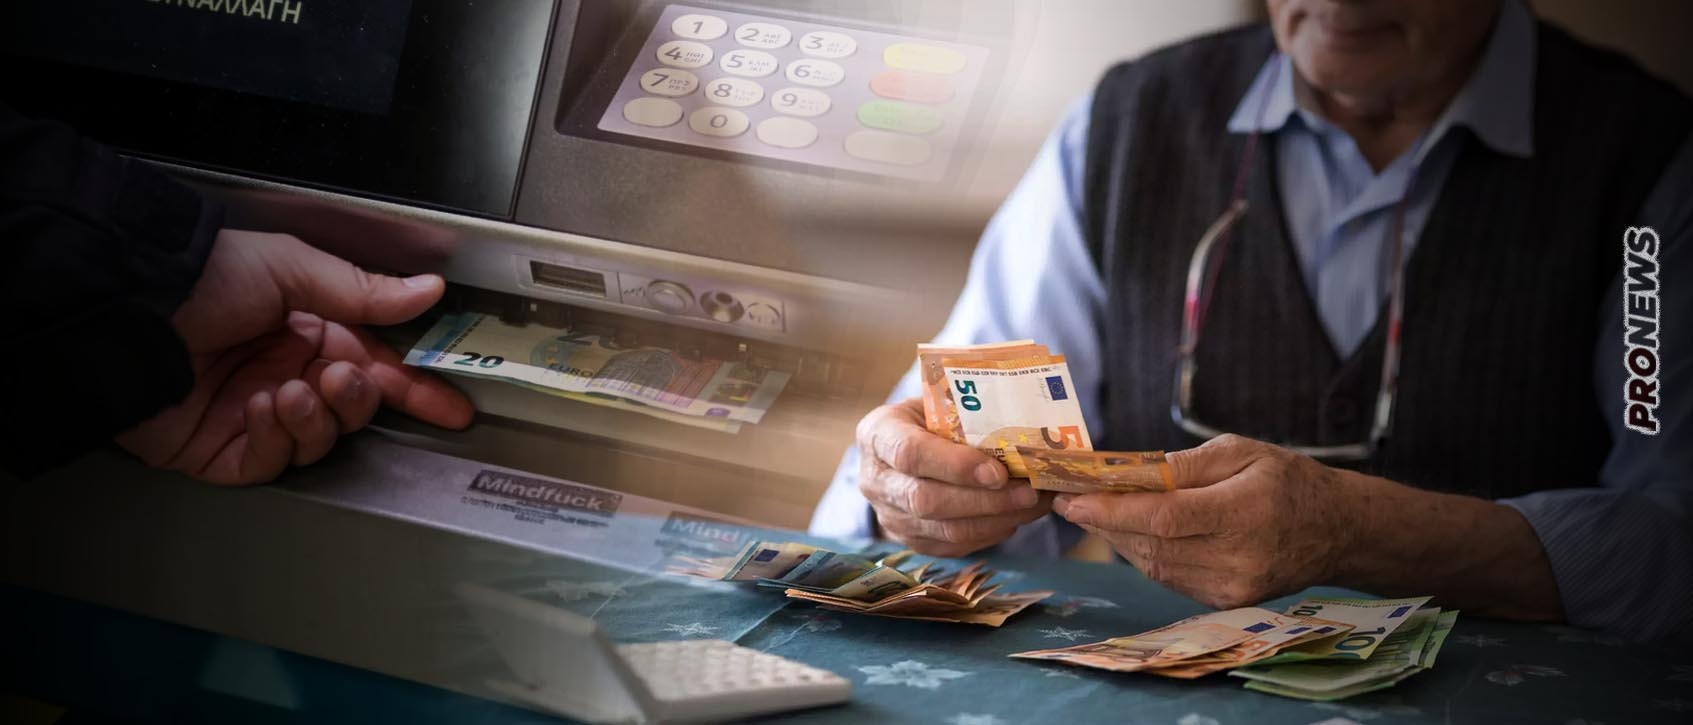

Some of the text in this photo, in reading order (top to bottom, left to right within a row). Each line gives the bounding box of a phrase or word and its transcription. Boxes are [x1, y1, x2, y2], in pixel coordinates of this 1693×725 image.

[147, 0, 301, 24] ΑΛΛΑΓΗ
[692, 21, 704, 34] 1
[740, 28, 760, 41] 2
[805, 35, 824, 49] 3
[664, 47, 682, 60] 4
[727, 55, 745, 67] 5
[794, 65, 812, 77] 6
[650, 73, 669, 87] 7
[714, 84, 732, 97] 8
[780, 93, 798, 107] 9
[710, 114, 728, 128] 0
[454, 352, 504, 368] 20
[954, 380, 982, 411] 50
[477, 474, 604, 510] Mindfuck
